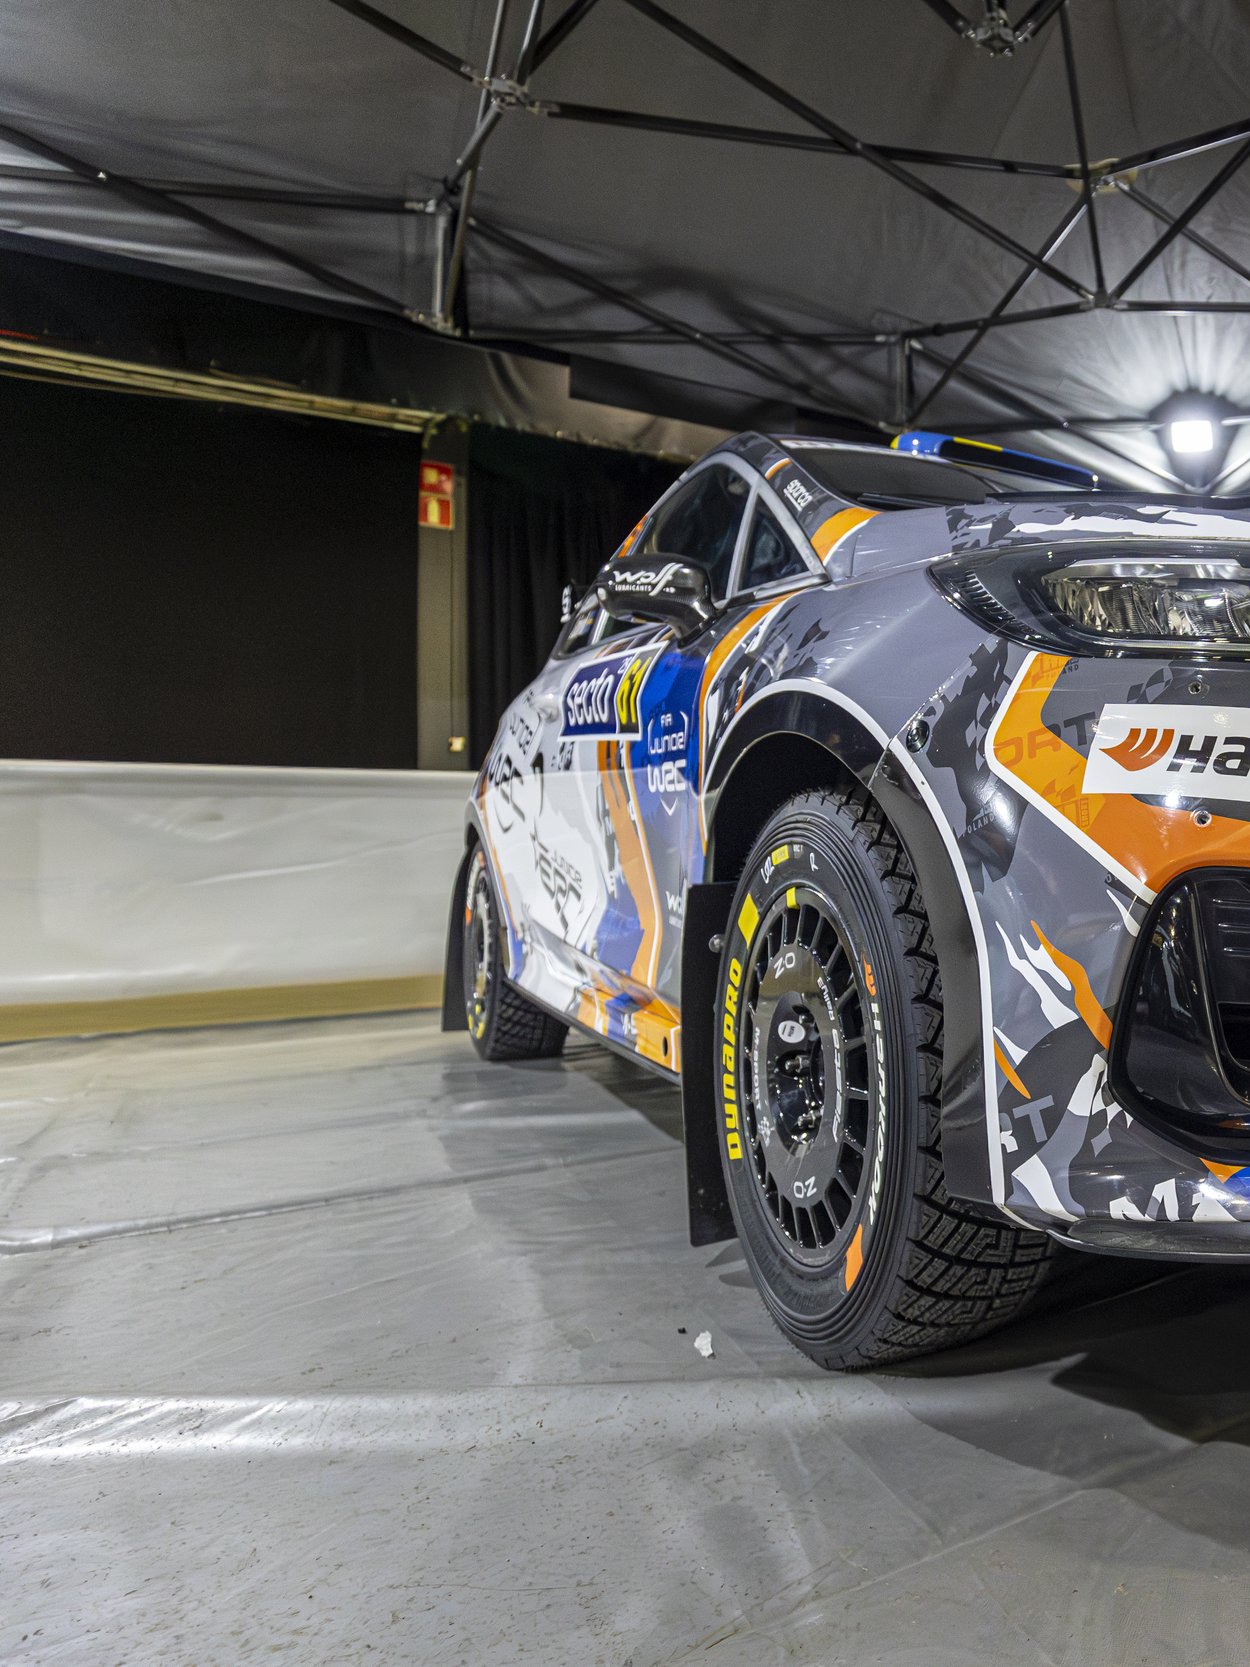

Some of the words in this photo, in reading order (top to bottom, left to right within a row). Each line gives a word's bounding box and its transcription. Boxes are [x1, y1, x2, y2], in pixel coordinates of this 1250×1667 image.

[614, 584, 653, 593] LUBRICANTS
[566, 667, 616, 727] secto
[616, 656, 653, 725] 61
[646, 758, 688, 794] WRC
